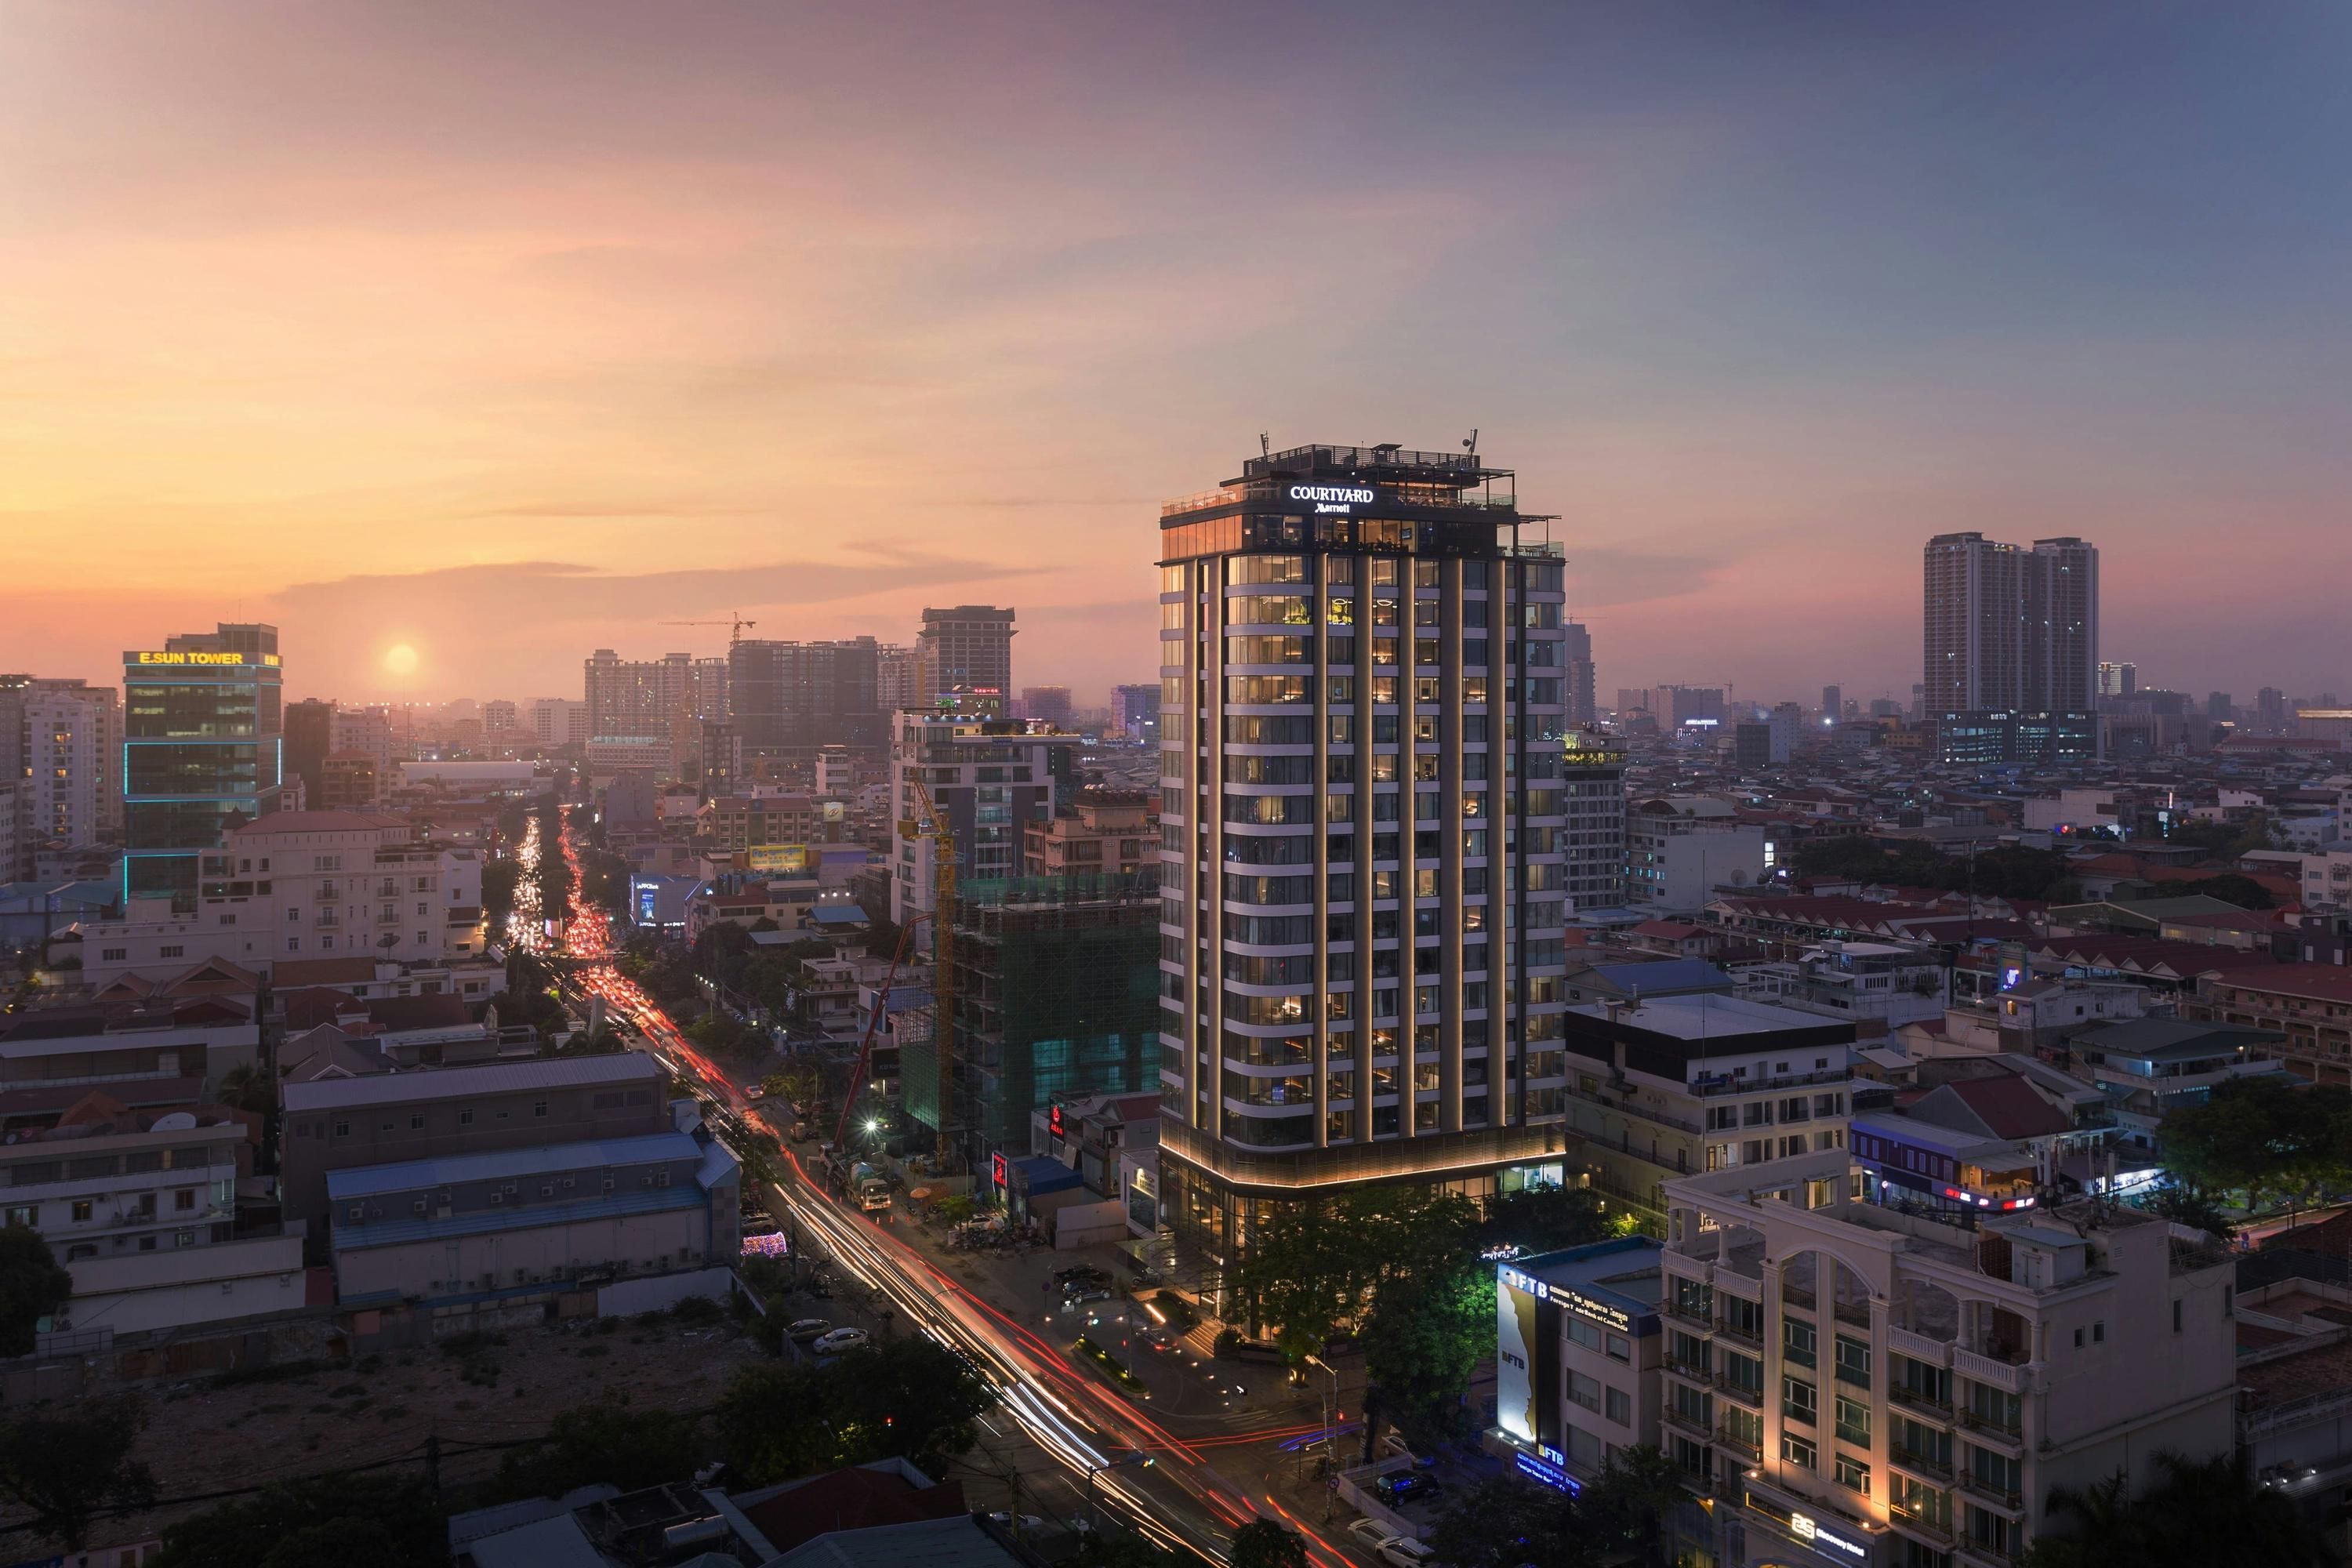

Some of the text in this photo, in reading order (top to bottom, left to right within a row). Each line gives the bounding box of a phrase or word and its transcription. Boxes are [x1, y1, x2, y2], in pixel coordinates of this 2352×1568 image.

[1290, 486, 1374, 503] COURTYARD
[1315, 503, 1349, 514] Marriott
[140, 652, 243, 665] E.SUN TOWER
[1519, 1273, 1548, 1298] FTB
[1550, 1296, 1570, 1308] Foreign
[1570, 1304, 1584, 1315] Tade
[1584, 1309, 1596, 1320] Bank
[1603, 1318, 1628, 1332] Cambodia
[1508, 1353, 1525, 1370] FTB
[1545, 1446, 1564, 1465] FTB
[1817, 1528, 1864, 1557] Discovery Hotel
